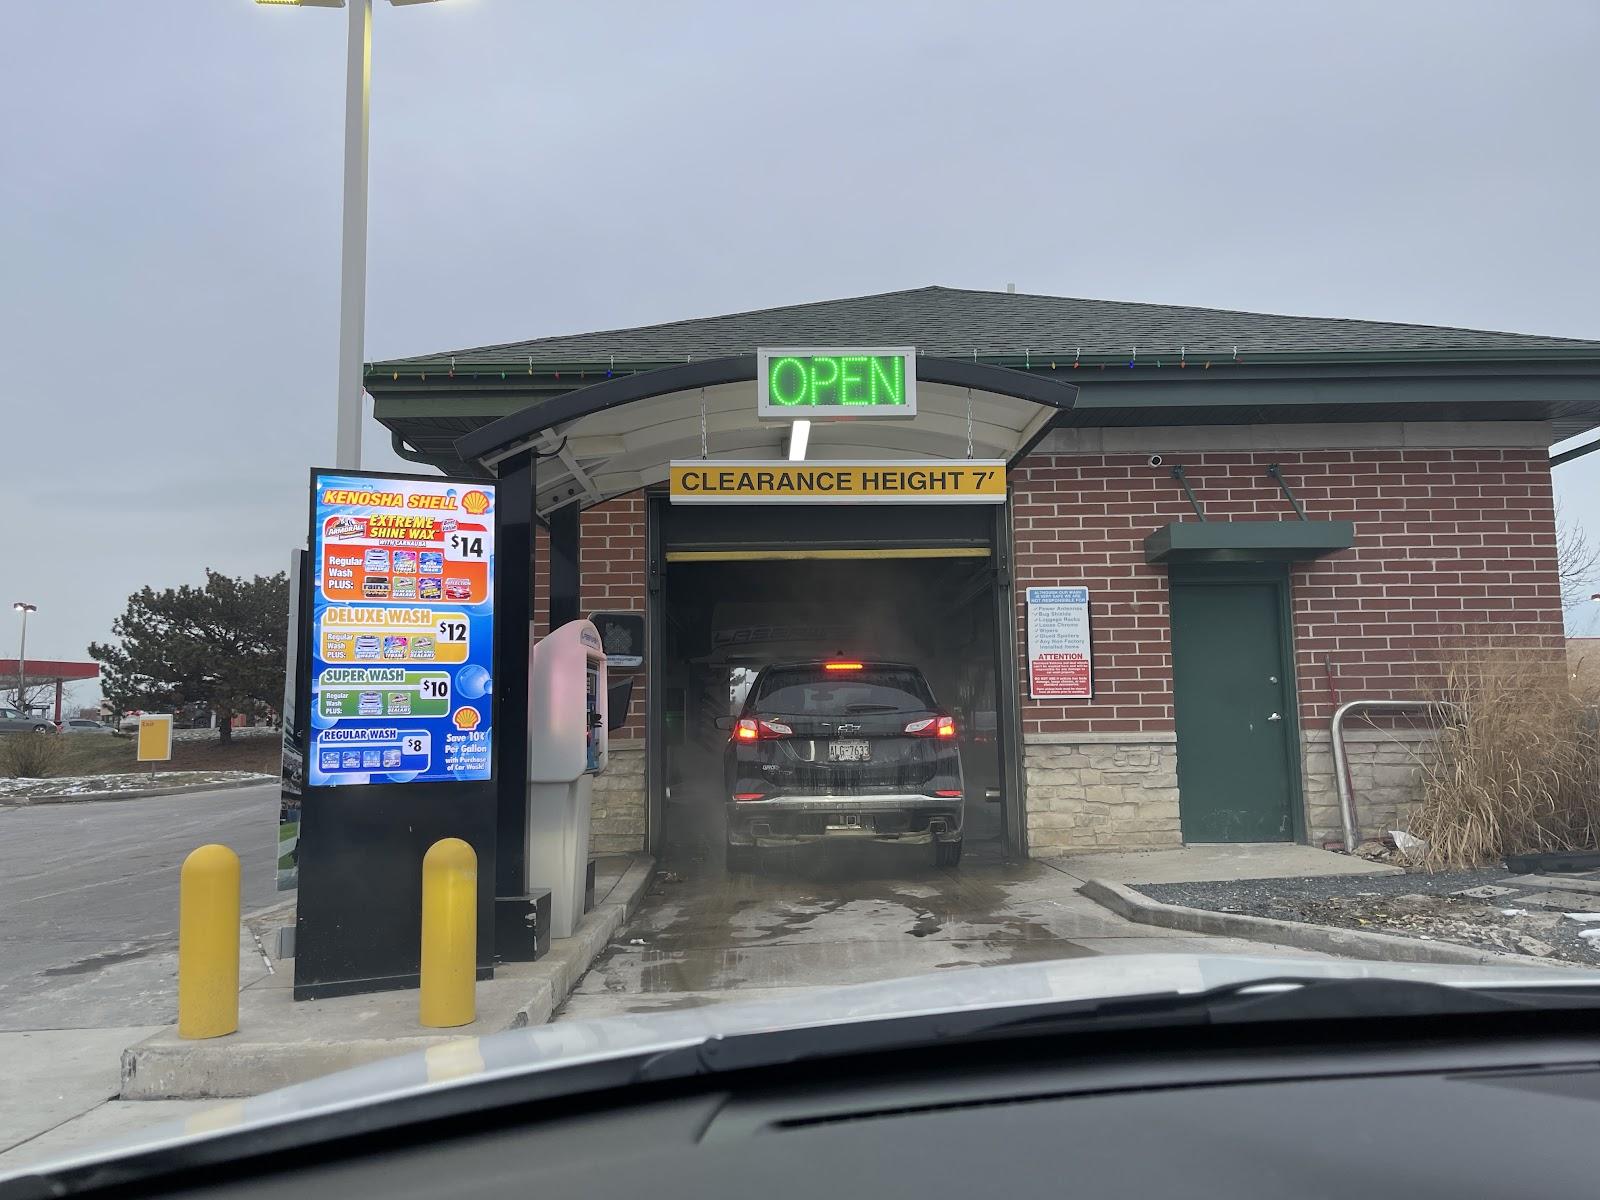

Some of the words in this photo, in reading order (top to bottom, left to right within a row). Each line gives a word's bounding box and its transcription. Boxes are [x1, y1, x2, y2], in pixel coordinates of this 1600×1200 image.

[772, 356, 900, 406] OPEN
[681, 471, 853, 491] CLEARANCE
[862, 471, 964, 491] HEIGHT
[323, 490, 403, 507] KENOSHA
[407, 494, 458, 510] SHELL
[369, 514, 435, 529] EXTREME
[370, 528, 405, 539] SHINE
[451, 534, 483, 557] $14
[329, 556, 363, 567] Regular
[329, 567, 353, 578] Wash
[329, 579, 354, 589] PLUS:
[327, 608, 384, 623] DELUXE
[388, 609, 431, 624] WASH
[440, 621, 467, 641] $12
[327, 633, 354, 642] Regular
[327, 642, 346, 650] Wash
[327, 651, 346, 659] PLUS:
[325, 669, 366, 682] SUPER
[369, 669, 404, 681] WASH
[424, 679, 448, 697] $10
[324, 730, 370, 740] REGULAR
[370, 729, 396, 739] WASH
[446, 733, 466, 742] Save
[408, 739, 422, 752] $8
[445, 744, 459, 754] Per
[460, 744, 487, 753] Gallon
[459, 756, 486, 764] Purchase
